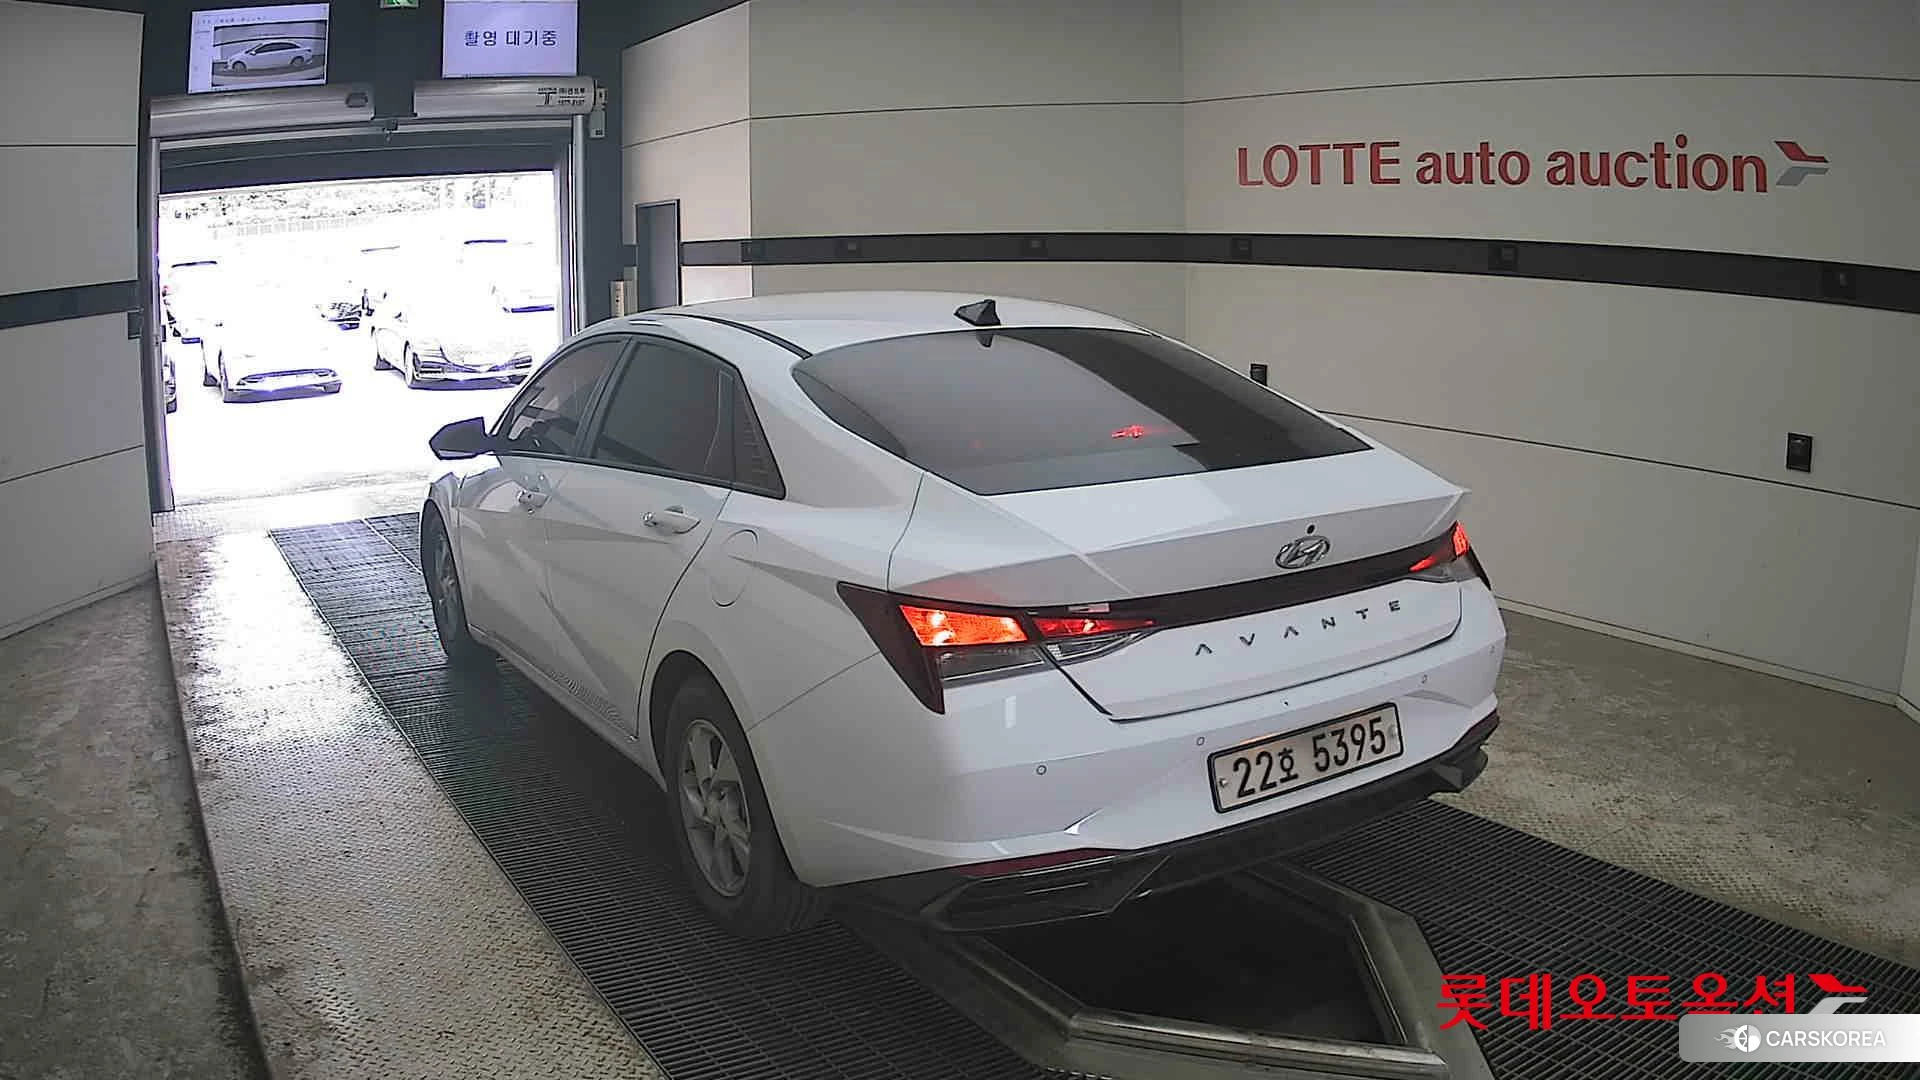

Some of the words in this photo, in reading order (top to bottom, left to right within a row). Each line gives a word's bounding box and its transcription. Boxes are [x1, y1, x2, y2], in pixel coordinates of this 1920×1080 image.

[505, 30, 558, 46] 대기중
[1237, 141, 1401, 187] LOTTE
[1415, 142, 1531, 186] auto
[1545, 133, 1770, 193] auction
[1194, 598, 1402, 657] AVANTE
[1232, 746, 1300, 799] 22호
[1311, 716, 1387, 773] 5395
